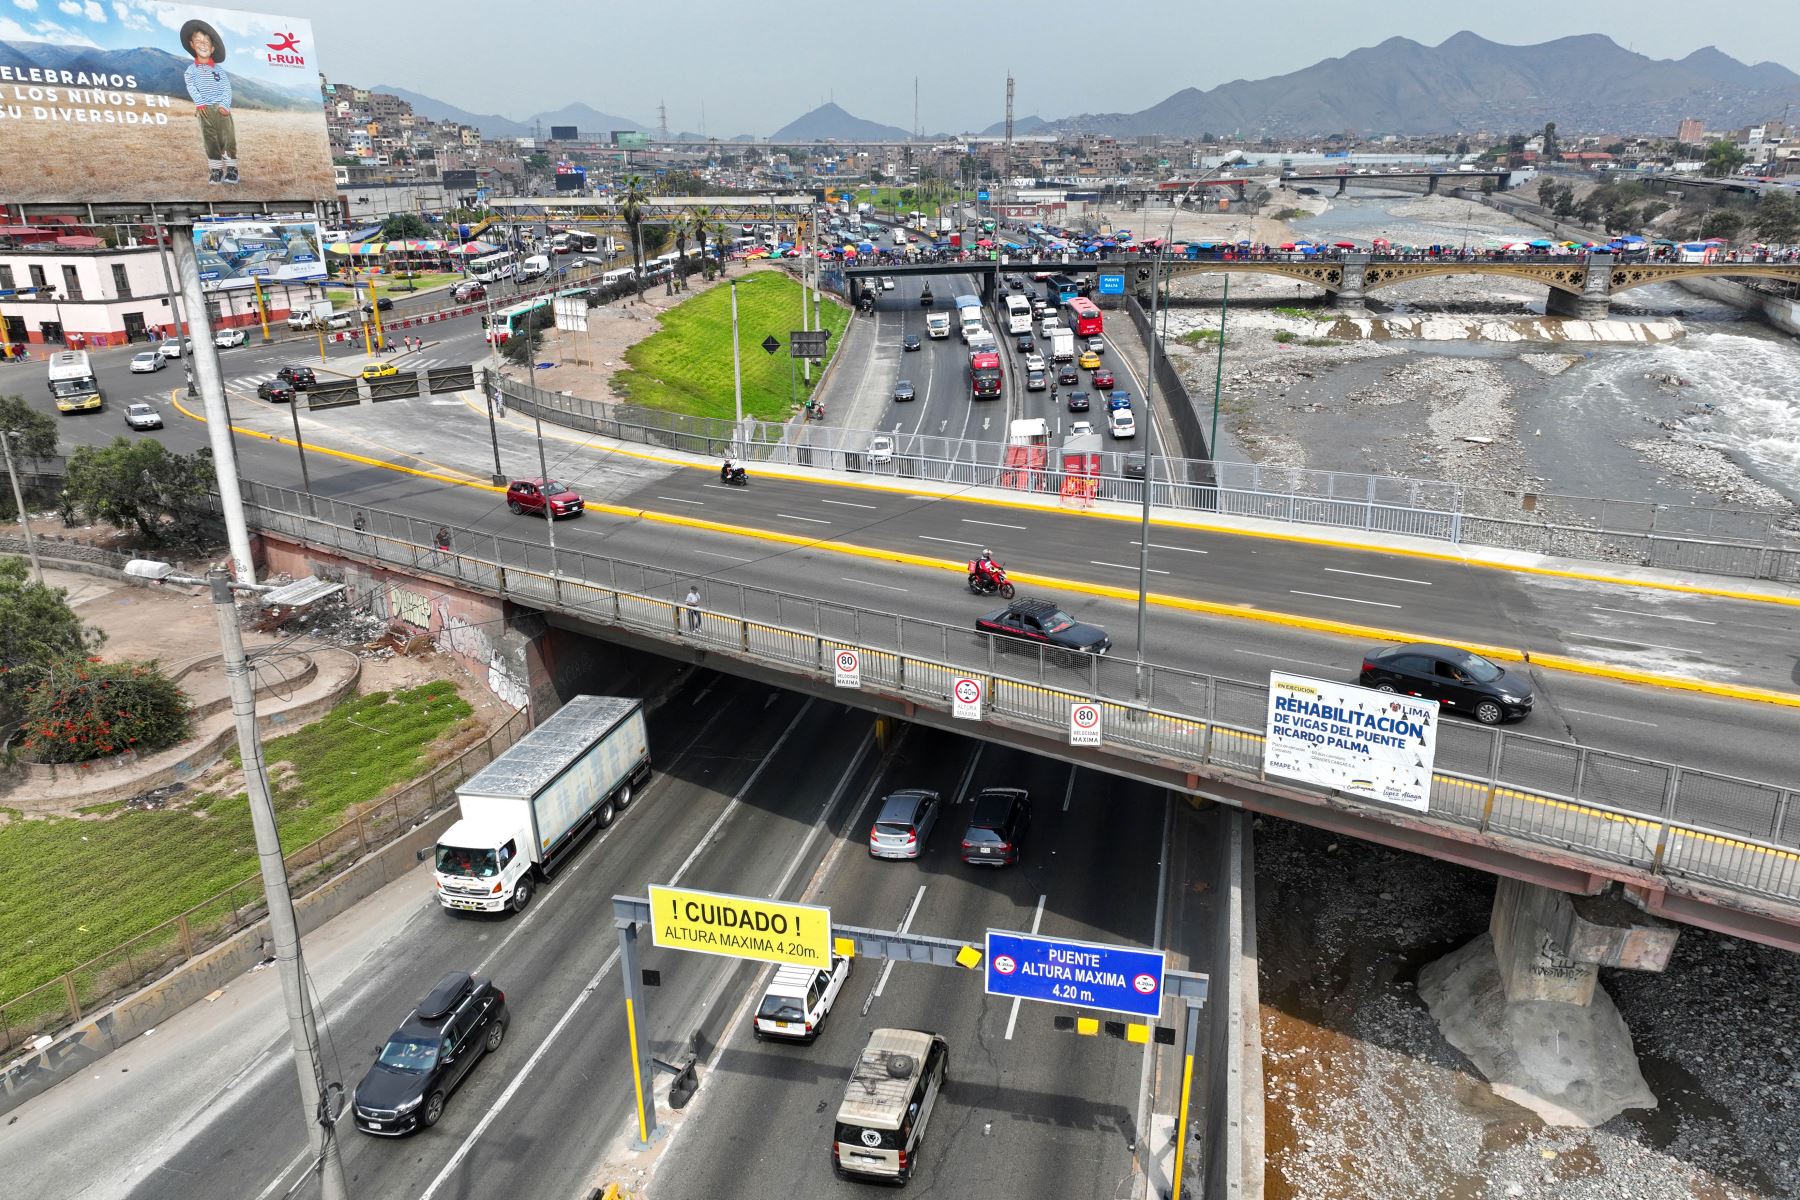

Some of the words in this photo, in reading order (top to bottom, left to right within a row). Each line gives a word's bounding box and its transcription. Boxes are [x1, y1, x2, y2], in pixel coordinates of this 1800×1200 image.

[267, 53, 305, 65] I-RUN
[14, 86, 58, 102] LOS
[68, 87, 136, 106] NIÑOS
[144, 94, 171, 108] EN
[33, 106, 168, 125] DIVERSIDAD
[841, 656, 853, 665] 80
[1079, 710, 1093, 720] 80
[1402, 706, 1430, 719] LIMA
[1273, 725, 1325, 744] RICARDO
[1327, 736, 1369, 754] PALMA
[1274, 712, 1290, 724] DE
[1292, 716, 1328, 732] VIGAS
[1330, 724, 1353, 738] DEL
[1356, 729, 1406, 749] PUENTE
[1270, 761, 1291, 769] EMAPE
[672, 899, 678, 919] !
[685, 901, 788, 934] CUIDADO
[795, 916, 801, 937] !
[665, 926, 717, 945] ALTURA
[720, 933, 774, 952] MAXIMA
[777, 942, 819, 959] 4.20m.
[1049, 948, 1100, 968] PUENTE
[1021, 961, 1072, 981] ALTURA
[1075, 968, 1126, 988] MAXIMA
[1052, 983, 1077, 999] 4.20
[1080, 990, 1095, 1002] m.
